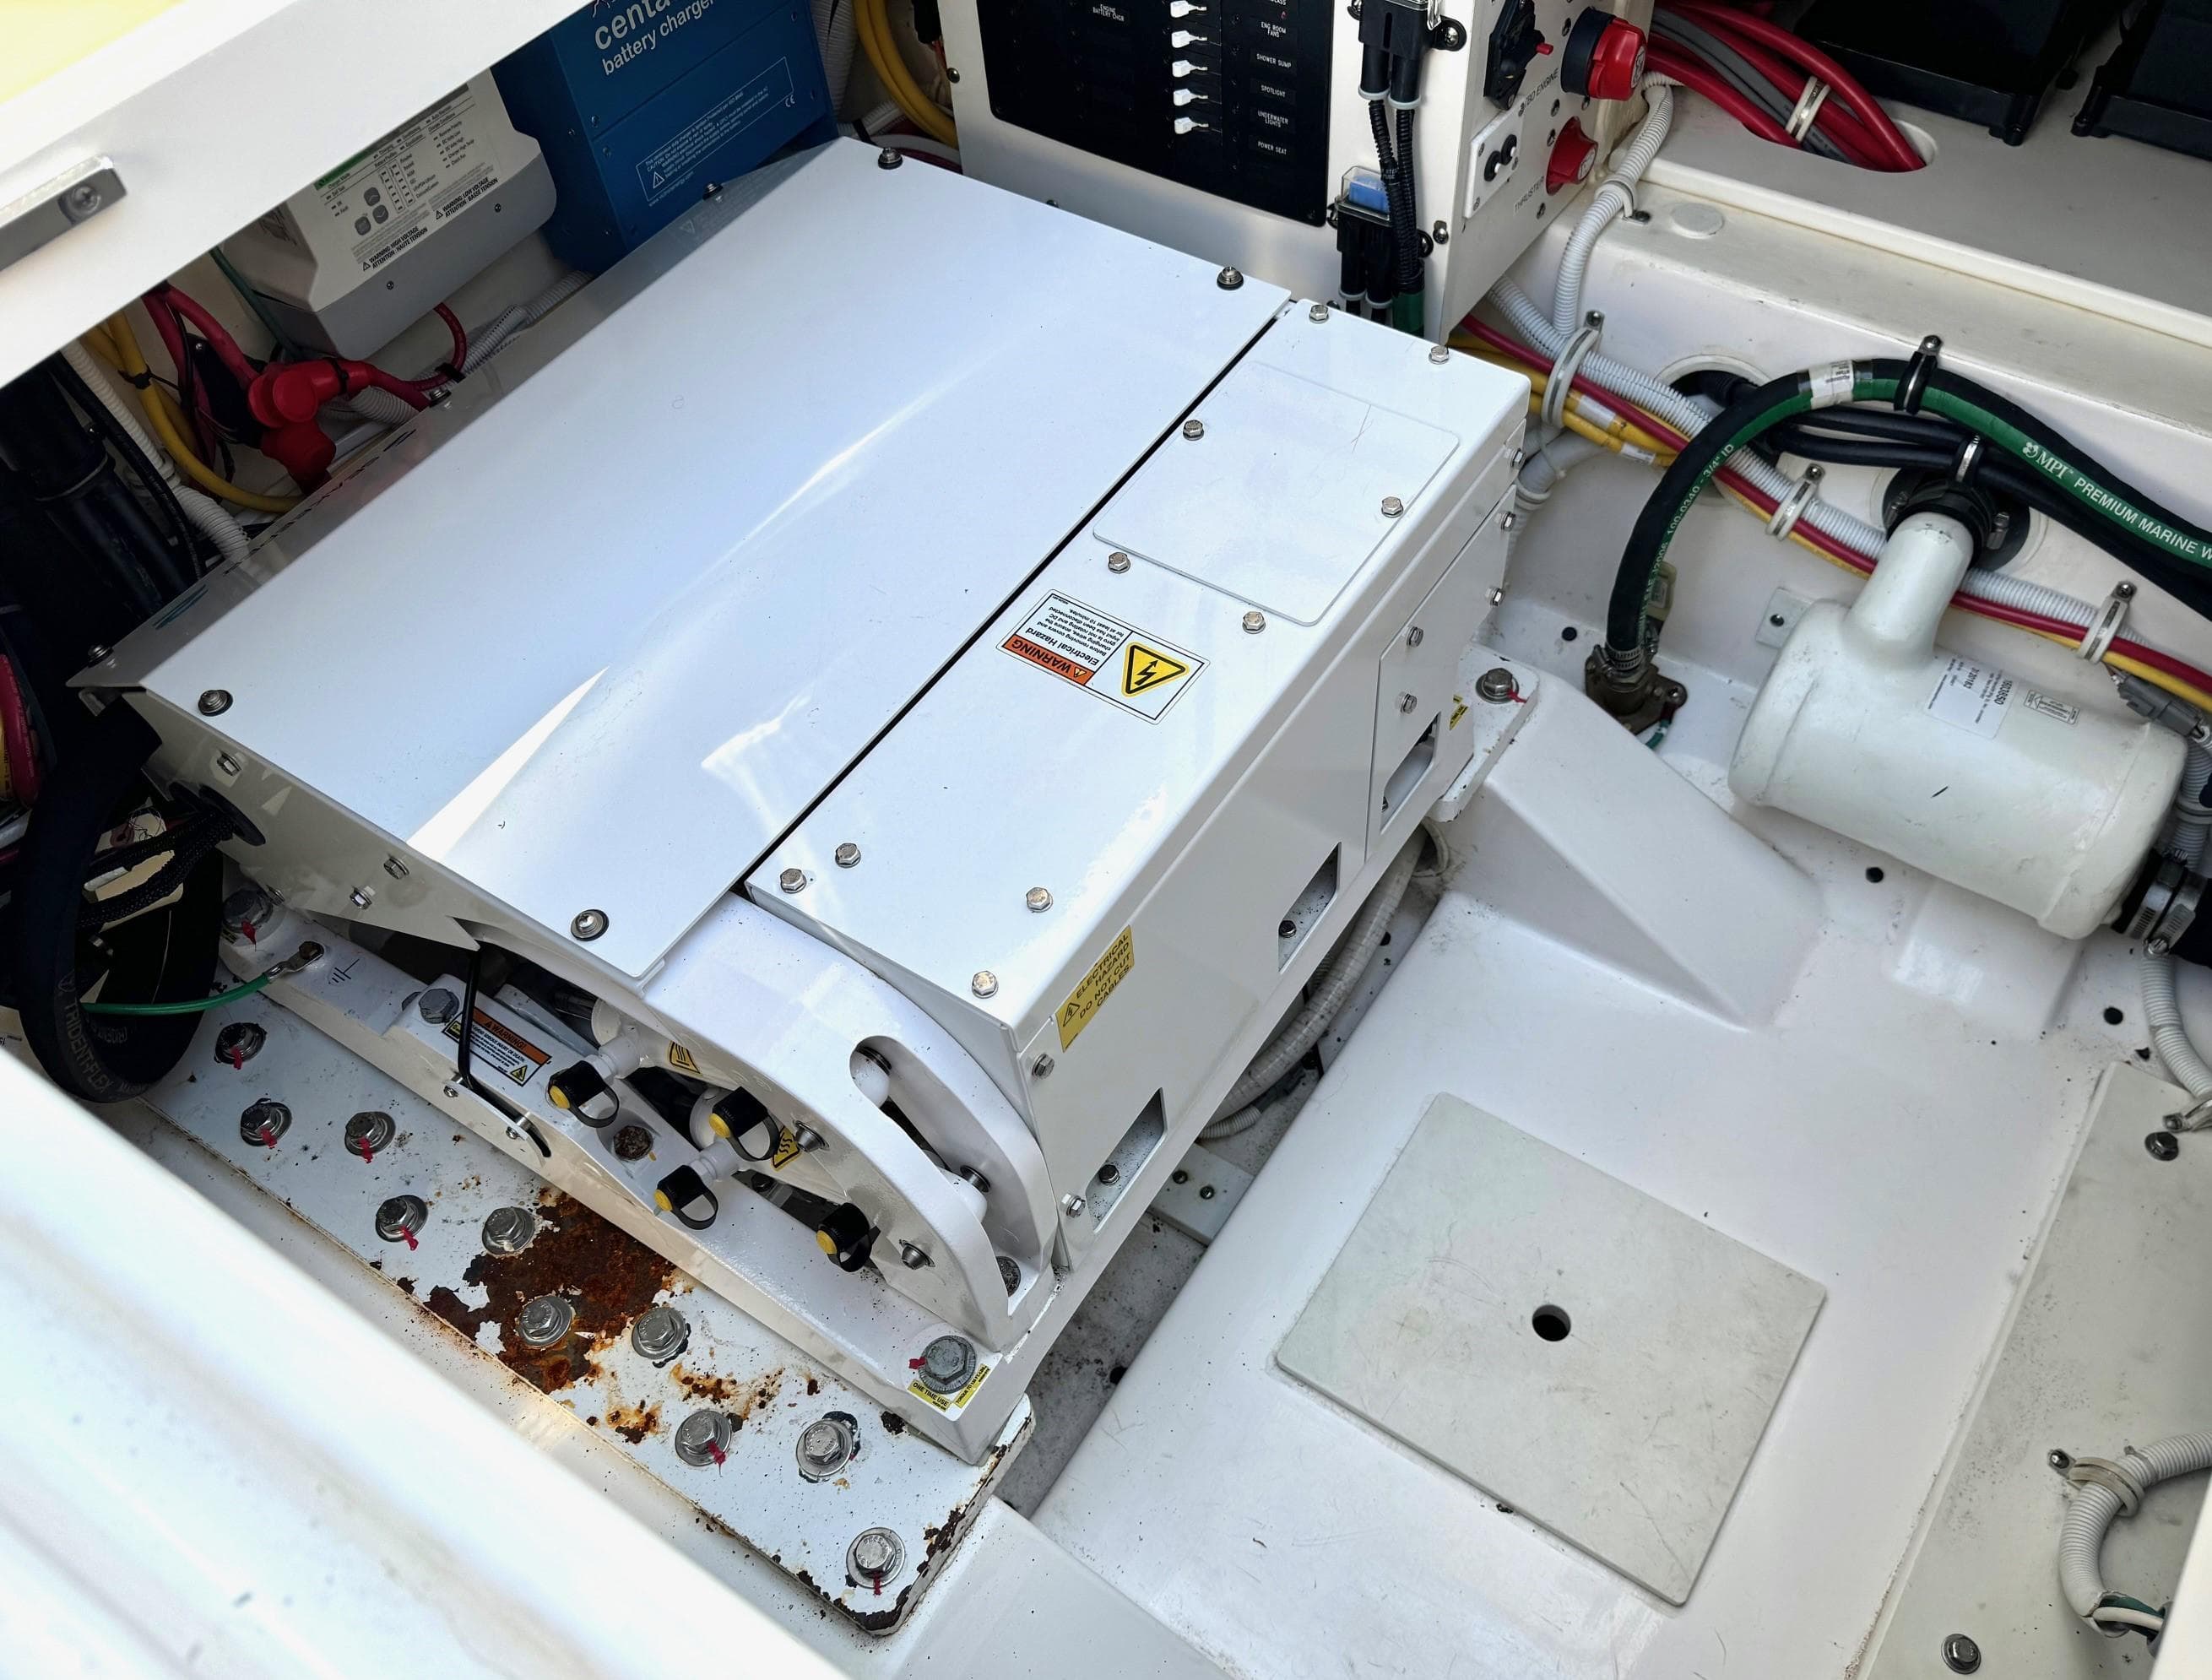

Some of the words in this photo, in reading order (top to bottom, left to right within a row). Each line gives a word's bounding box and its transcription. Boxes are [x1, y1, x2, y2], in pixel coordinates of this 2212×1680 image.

[1261, 21, 1271, 30] ENG
[1272, 24, 1287, 34] ROOM
[1267, 29, 1280, 38] FANS
[602, 30, 656, 76] battery
[1256, 53, 1277, 65] SHOWER
[1277, 60, 1292, 68] SUMP
[1536, 68, 1559, 97] ENGINE
[1261, 84, 1286, 98] SPOTLIGHT
[1257, 110, 1289, 125] UNDERWATER
[1265, 118, 1282, 127] LIGHTS
[1257, 141, 1274, 151] POWER
[1275, 147, 1288, 155] SEAT
[462, 188, 473, 198] LOW
[471, 176, 489, 191] VOLTAGE
[480, 177, 498, 192] TENSION
[1515, 176, 1545, 212] THRUSTER
[390, 238, 402, 248] HIGH
[400, 225, 419, 241] VOLTAGE
[396, 240, 409, 252] HAUTE
[409, 226, 427, 241] TENSION
[1721, 443, 1735, 458] ID
[2074, 477, 2139, 524] PREMIUM
[2139, 518, 2198, 554] MARINE
[1048, 605, 1083, 625] disconnected
[1067, 608, 1090, 621] minutes.
[1047, 625, 1065, 636] covers
[1053, 621, 1071, 631] ensure
[1067, 621, 1089, 633] rotating
[1082, 621, 1096, 631] been
[1096, 621, 1110, 630] least
[1024, 626, 1058, 645] Hazard
[1065, 633, 1090, 648] removing
[1071, 629, 1087, 640] wires,
[1102, 637, 1116, 646] gyro
[1086, 636, 1112, 651] changing
[1011, 638, 1072, 673] WARNING
[1056, 642, 1100, 665] Electrical
[1076, 934, 1128, 999] ELECTRICAL
[1095, 942, 1130, 987] HAZARD
[1080, 1000, 1092, 1019] DO
[1094, 976, 1111, 1001] NOT
[1114, 952, 1130, 976] CUT
[491, 1024, 527, 1049] WARNING!
[913, 1381, 924, 1392] ONE
[924, 1389, 938, 1401] TIME
[937, 1395, 949, 1407] USE
